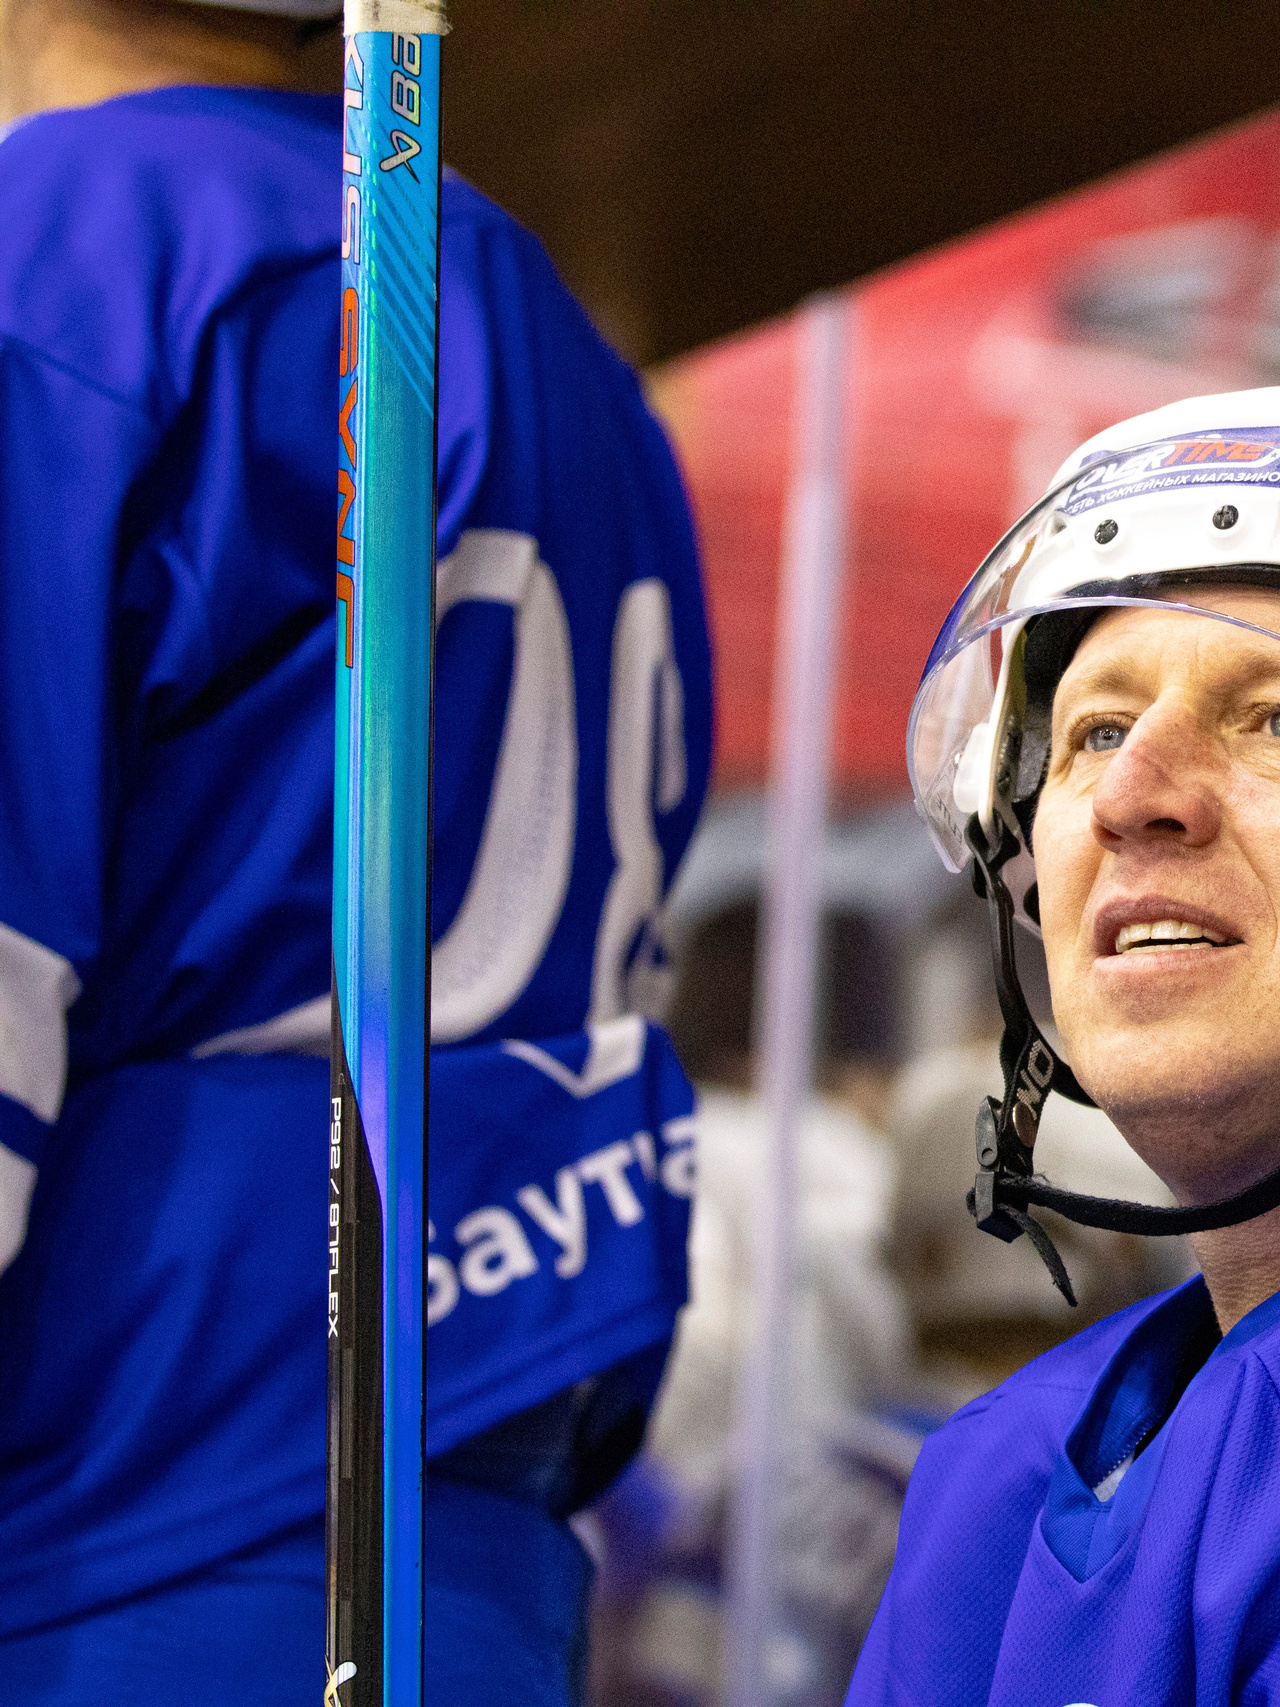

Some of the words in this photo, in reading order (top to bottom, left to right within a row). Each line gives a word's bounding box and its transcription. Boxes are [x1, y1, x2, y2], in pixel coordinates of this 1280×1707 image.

[1100, 474, 1191, 504] ХОККЕЙНЫХ
[329, 1096, 342, 1170] P92
[327, 1203, 340, 1339] 87FLEX
